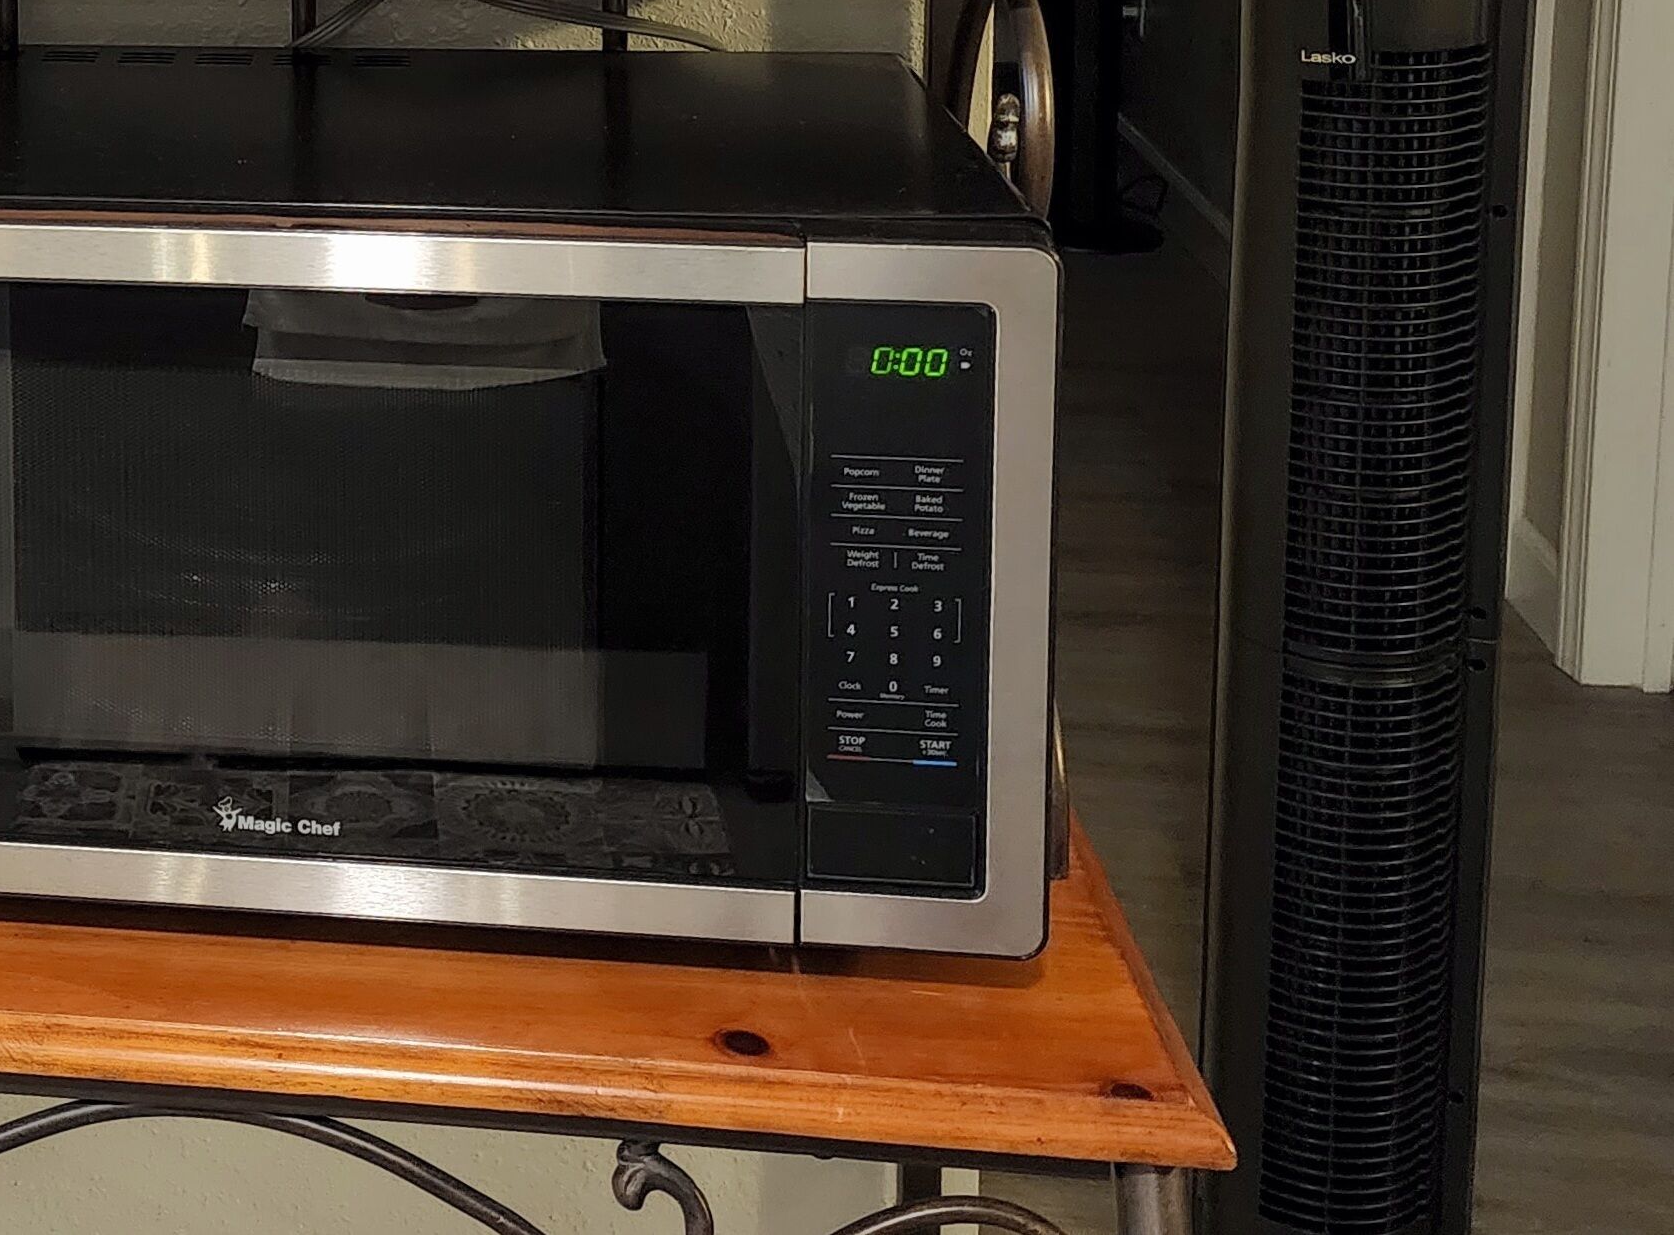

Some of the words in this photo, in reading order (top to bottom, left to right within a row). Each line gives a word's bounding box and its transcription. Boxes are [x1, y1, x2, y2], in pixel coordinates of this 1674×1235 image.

[1300, 49, 1357, 65] Lasko
[870, 346, 949, 377] 0:00
[843, 467, 880, 478] Popcorn
[914, 466, 946, 475] Dinner
[918, 475, 941, 484] Plate
[849, 492, 879, 502] Frozen
[915, 495, 943, 505] Baked
[842, 501, 886, 512] Vegetable
[914, 504, 944, 514] Potato
[852, 526, 875, 535] Pizza
[908, 528, 949, 540] Beverage
[846, 549, 880, 561] Weight
[917, 552, 940, 562] Time
[846, 559, 880, 569] Defrost
[911, 562, 945, 572] Defrost
[899, 584, 919, 593] Cook
[848, 596, 855, 608] 1
[890, 599, 899, 610] 2
[934, 600, 943, 612] 3
[846, 624, 856, 636] 4
[890, 626, 899, 637] 5
[933, 628, 942, 640] 6
[846, 651, 855, 663] 7
[889, 653, 898, 665] 8
[932, 655, 942, 667] 9
[838, 681, 862, 691] Clock
[888, 681, 898, 692] 0
[924, 685, 949, 694] Timer
[836, 710, 864, 720] Power
[925, 710, 947, 719] Time
[925, 719, 947, 728] Cook
[838, 735, 866, 745] STOP
[920, 740, 952, 750] START
[237, 815, 292, 835] Magic
[297, 819, 341, 837] Chef
